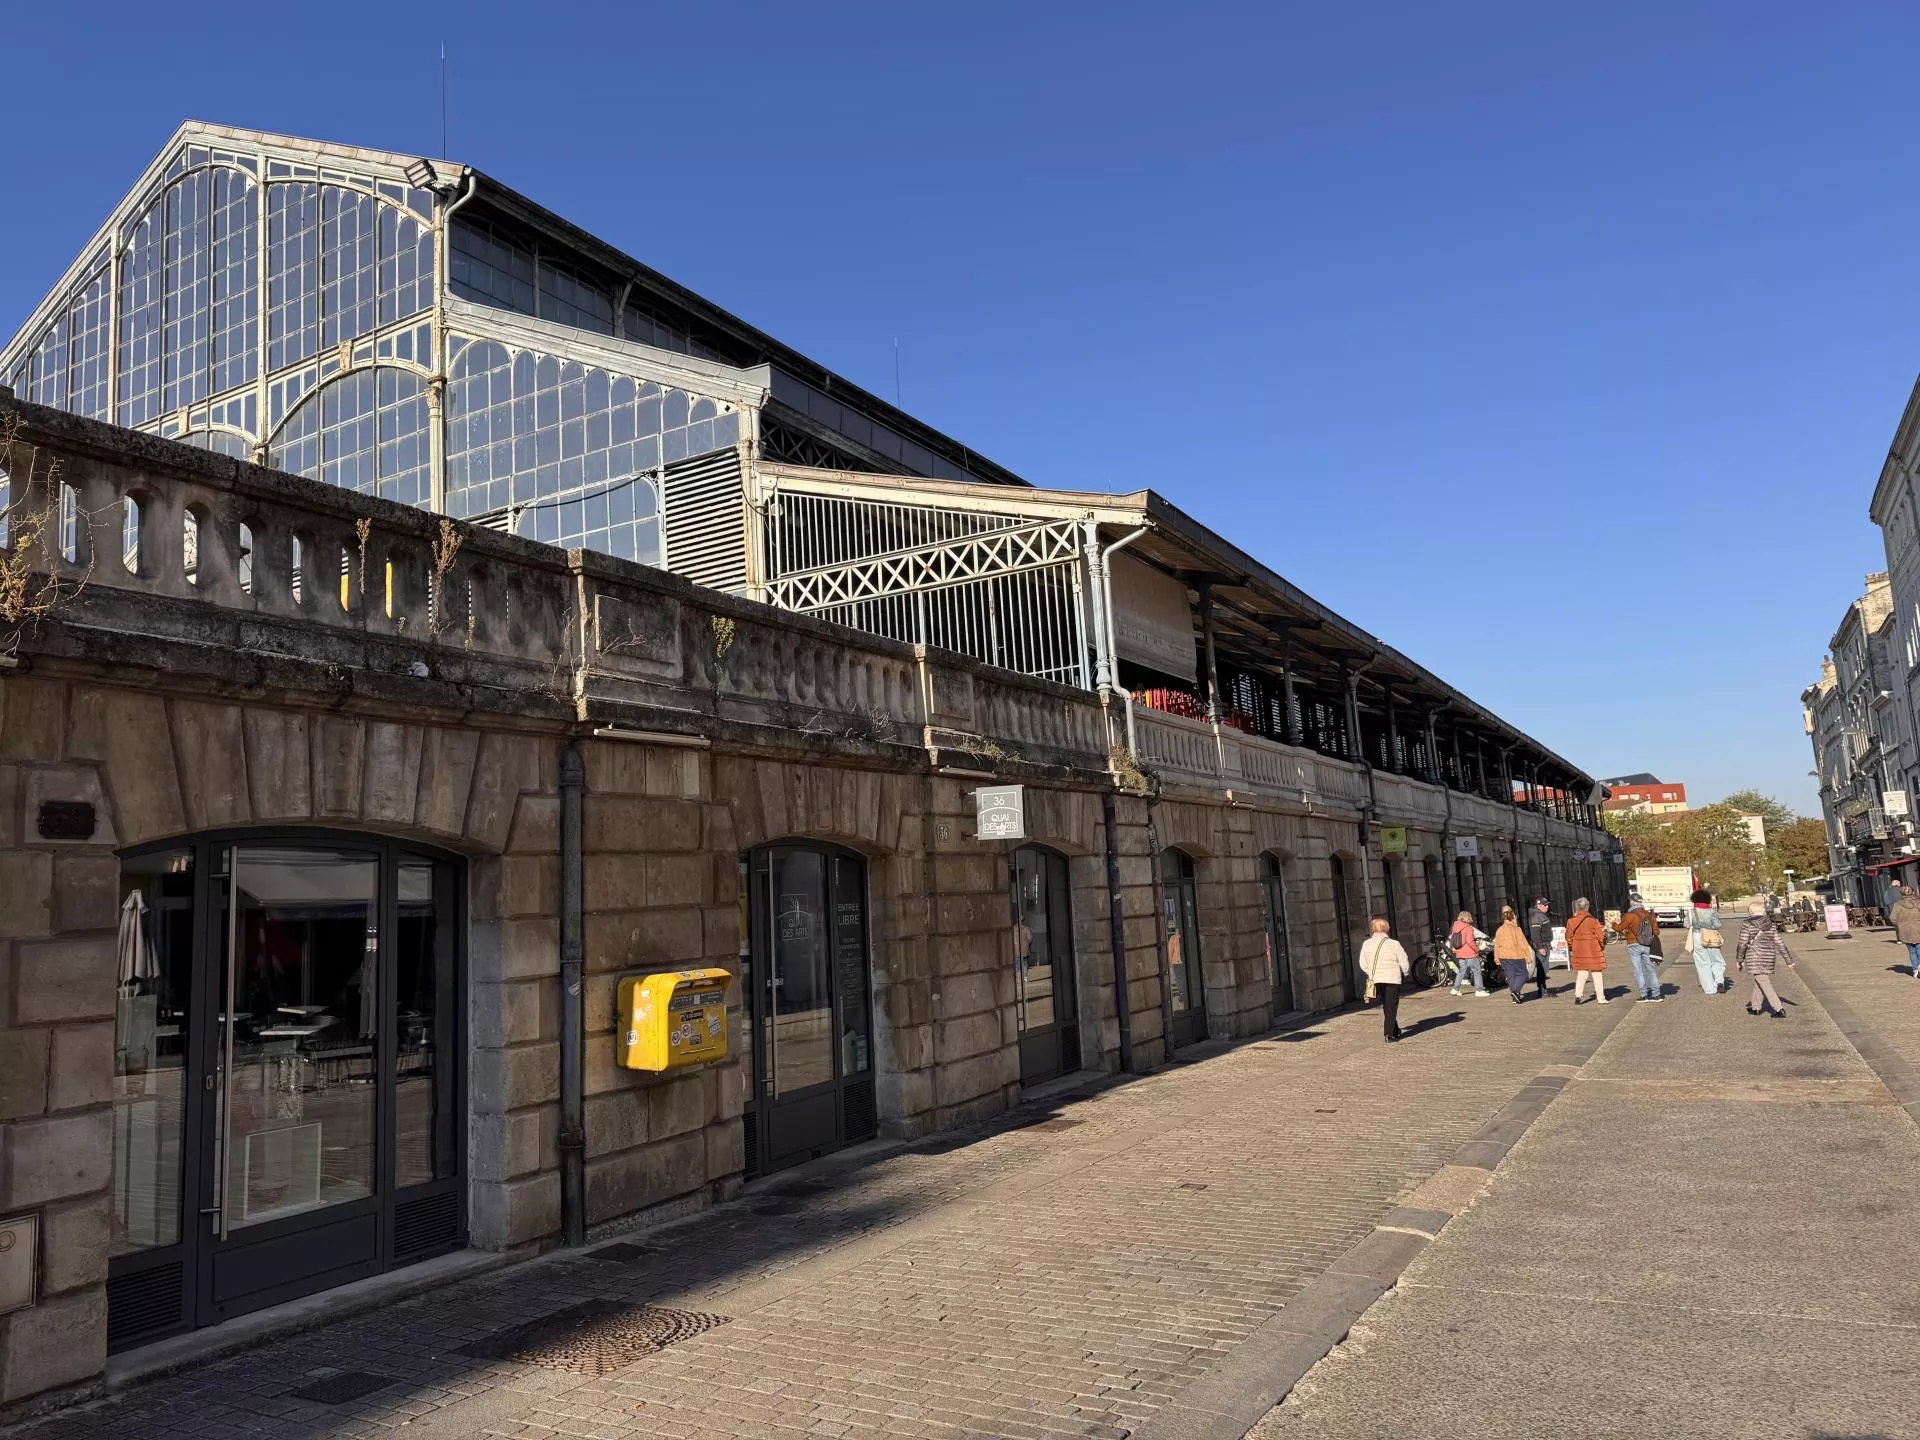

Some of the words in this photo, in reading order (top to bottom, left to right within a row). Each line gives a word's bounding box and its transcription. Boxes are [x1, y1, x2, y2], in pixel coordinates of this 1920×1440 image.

[993, 796, 1005, 806] 36
[991, 813, 1009, 822] QUAI
[984, 822, 997, 831] DES
[838, 914, 860, 926] LIBRE
